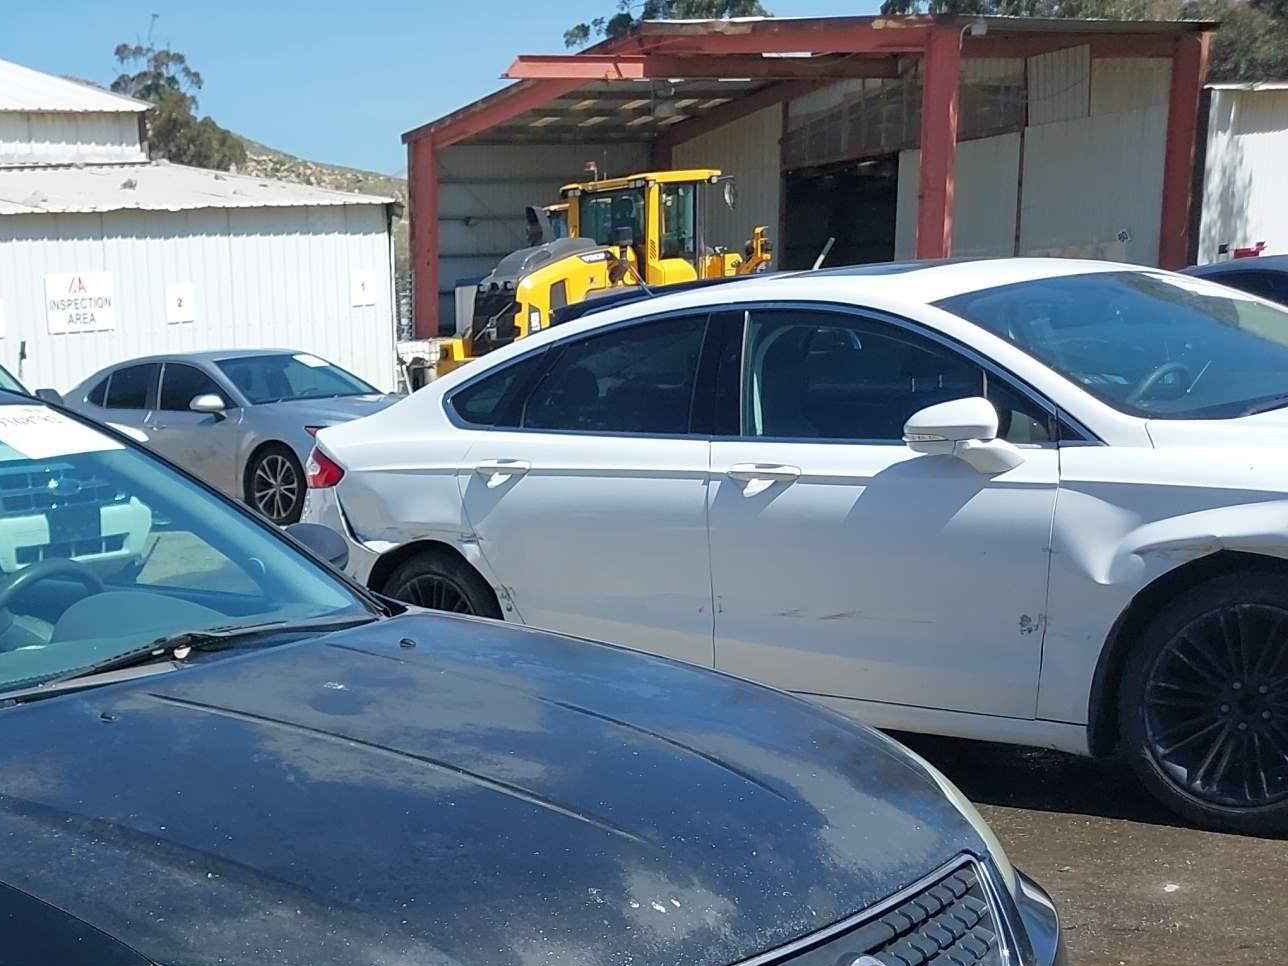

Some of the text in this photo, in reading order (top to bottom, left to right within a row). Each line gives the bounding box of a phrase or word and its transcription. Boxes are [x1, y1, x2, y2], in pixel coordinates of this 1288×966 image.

[49, 297, 112, 311] INSPECTION
[176, 297, 183, 308] 2
[67, 312, 97, 325] AREA
